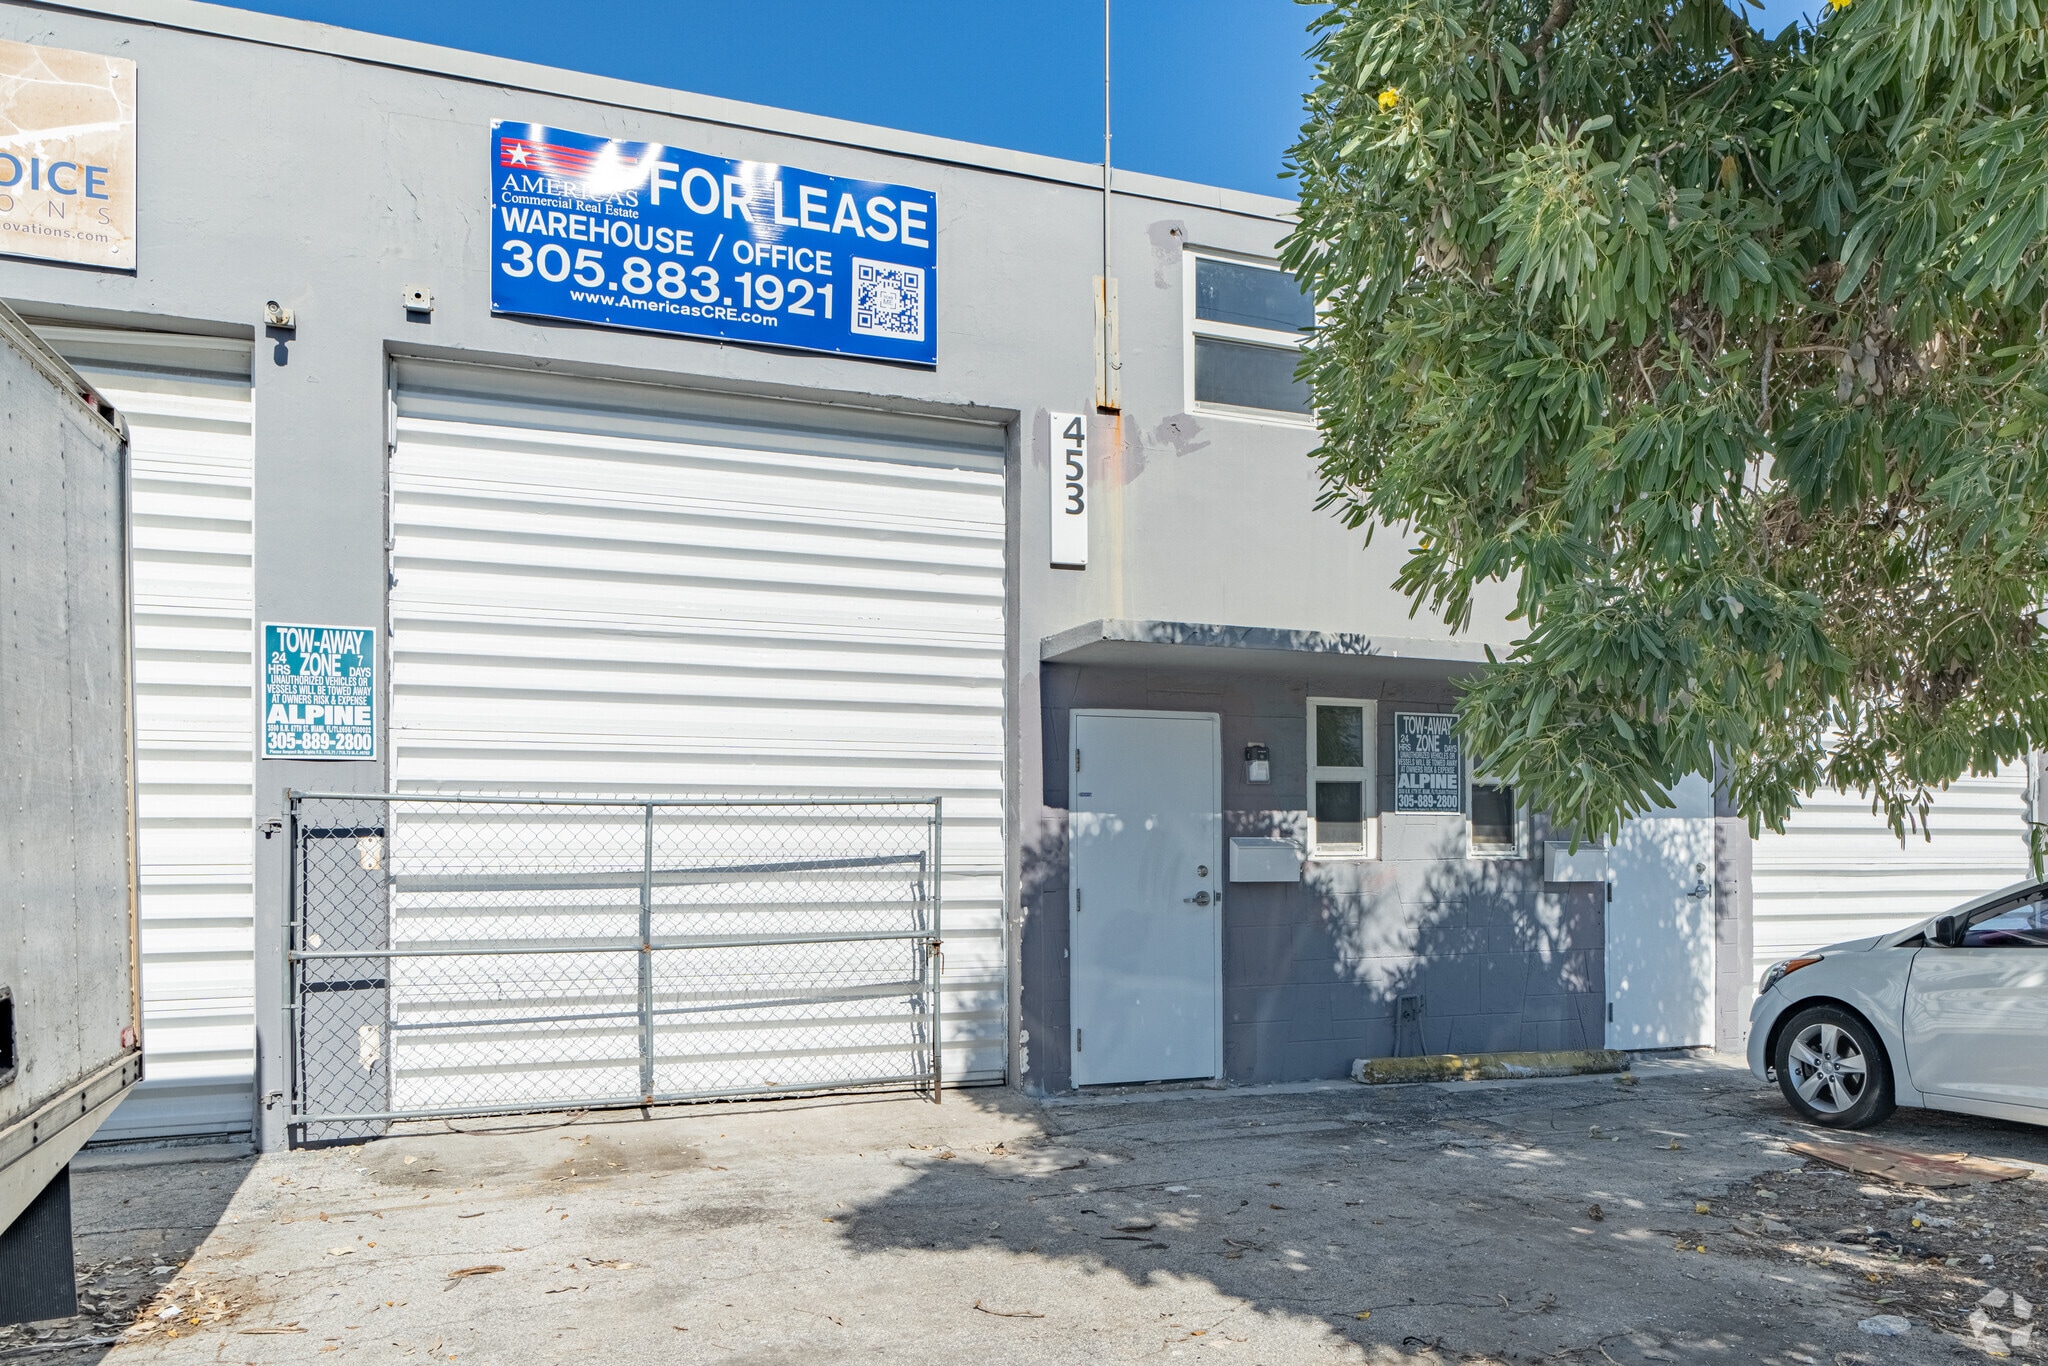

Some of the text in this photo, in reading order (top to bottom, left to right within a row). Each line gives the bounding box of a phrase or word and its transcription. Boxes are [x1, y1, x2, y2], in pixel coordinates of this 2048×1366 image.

[501, 192, 639, 219] Commercial Real Estate
[650, 160, 929, 249] FOR LEASE
[501, 206, 694, 256] WAREHOUSE
[733, 240, 833, 276] OFFICE
[501, 239, 833, 320] 305.883.1921
[570, 290, 778, 326] www.AmericasCRE.com
[1063, 416, 1085, 515] 453
[277, 627, 364, 654] TOW-AWAY
[272, 652, 287, 664] 24
[300, 653, 341, 676] ZONE
[357, 655, 363, 666] 7
[268, 664, 291, 675] HRS
[349, 667, 371, 677] DAYS
[271, 675, 368, 687] UNAUTHORIZED VEHICLES OR
[267, 684, 371, 696] VESSELS WILL BE TOWED AWAY
[272, 694, 367, 706] AT OWNERS RISK & EXPENSE
[267, 704, 371, 725] ALPINE
[1403, 716, 1452, 735] TOW-AWAY
[268, 731, 371, 750] 305-889-2800
[1401, 734, 1409, 743] 24
[1416, 735, 1440, 752] ZONE
[1399, 744, 1411, 752] HRS
[1444, 745, 1457, 753] DAYS
[1398, 773, 1457, 789] ALPINE
[1399, 795, 1457, 807] 305-889-2800
